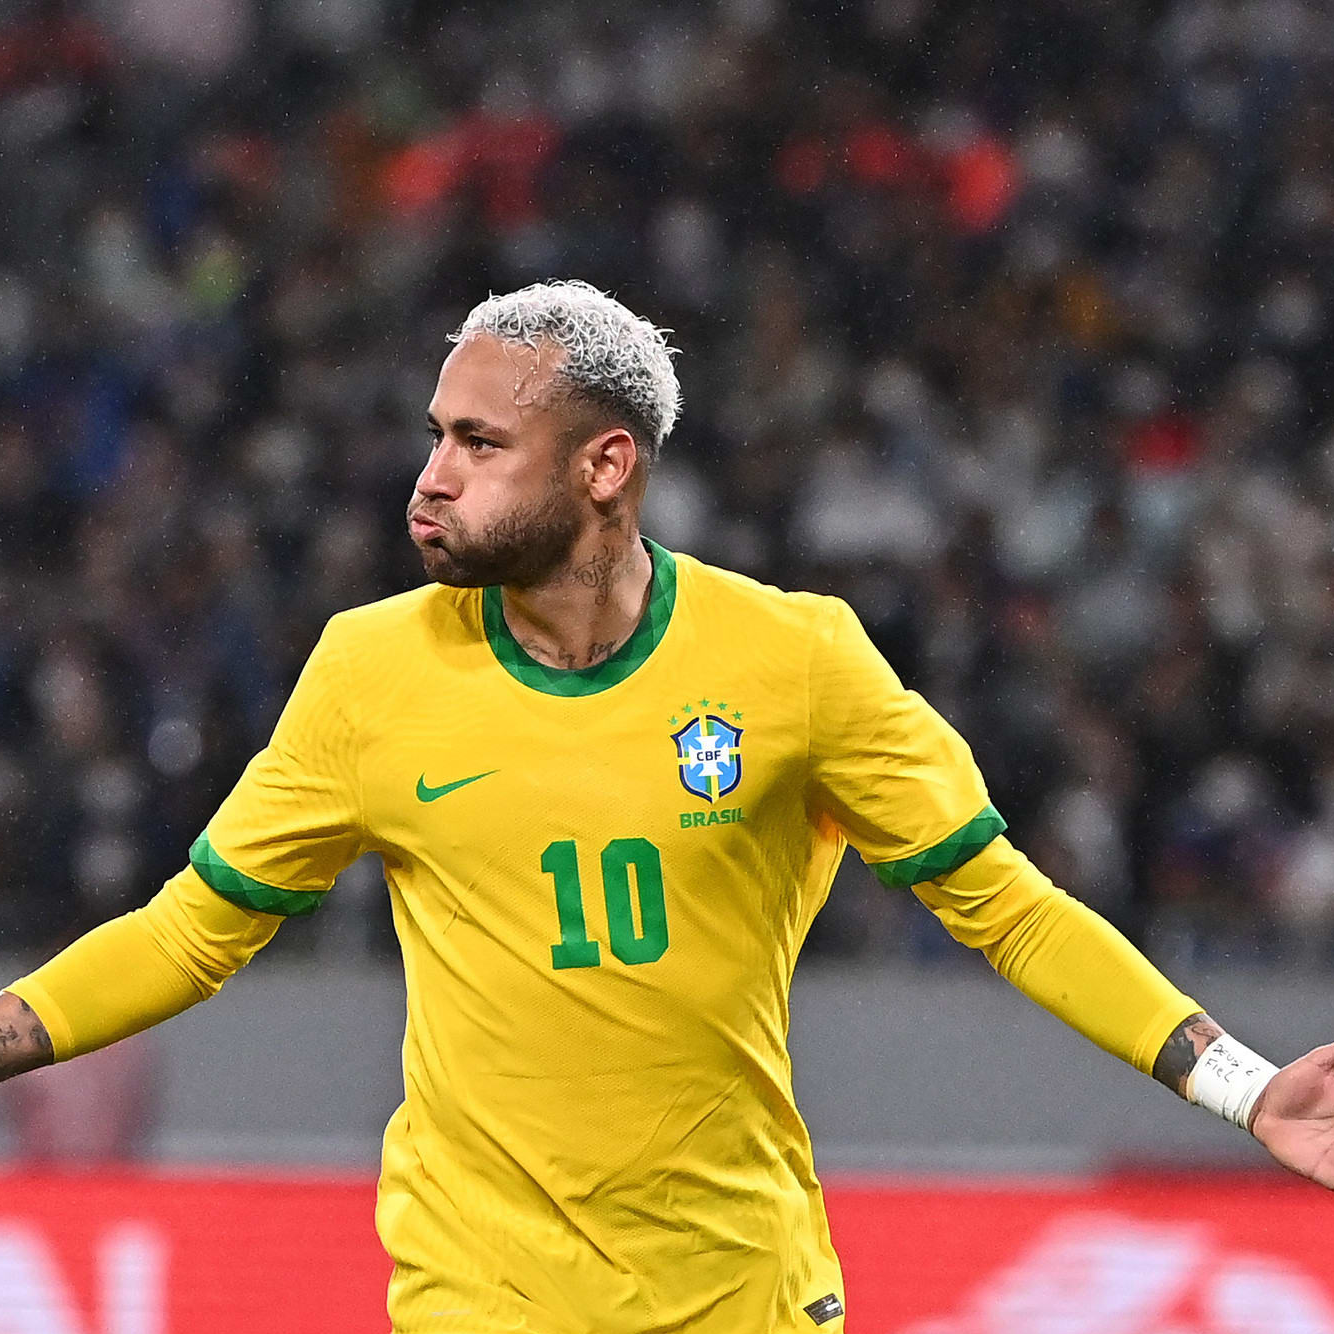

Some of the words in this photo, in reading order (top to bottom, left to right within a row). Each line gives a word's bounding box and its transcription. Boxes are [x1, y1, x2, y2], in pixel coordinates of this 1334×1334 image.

[696, 749, 722, 762] CBF
[679, 807, 745, 829] BRASIL
[540, 837, 670, 970] 10
